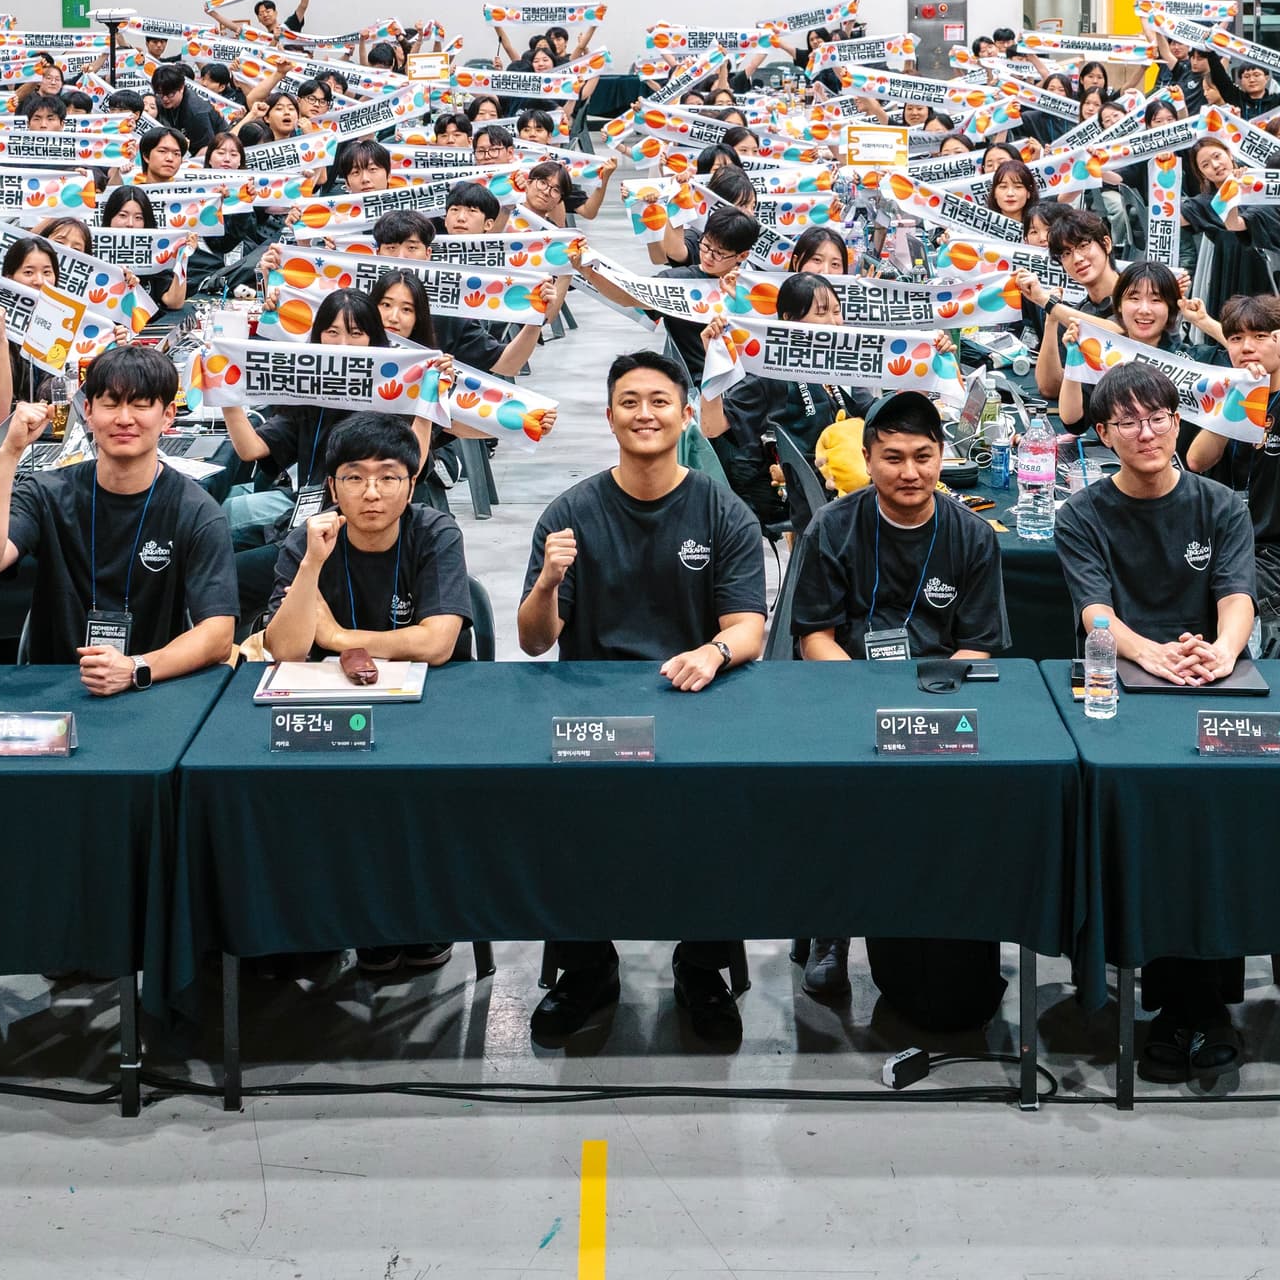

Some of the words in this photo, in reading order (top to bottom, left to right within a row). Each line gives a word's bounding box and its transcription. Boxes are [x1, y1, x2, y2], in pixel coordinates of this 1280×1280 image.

[491, 80, 541, 92] 네멋대로해
[492, 74, 541, 84] 모험의시작
[339, 108, 393, 134] 네멋대로해
[340, 100, 390, 121] 모험의시작
[8, 135, 76, 147] 모험의시작
[1129, 123, 1190, 146] 모험의시작
[1132, 131, 1193, 156] 네멋대로해
[8, 142, 76, 158] 네멋대로해
[363, 182, 451, 206] 모험의시작
[843, 303, 934, 322] 멋대로해
[766, 327, 885, 353] 모험의시작
[246, 351, 375, 378] 모험의시작
[763, 345, 883, 374] 네멋대로해
[246, 371, 374, 398] 네멋대로해
